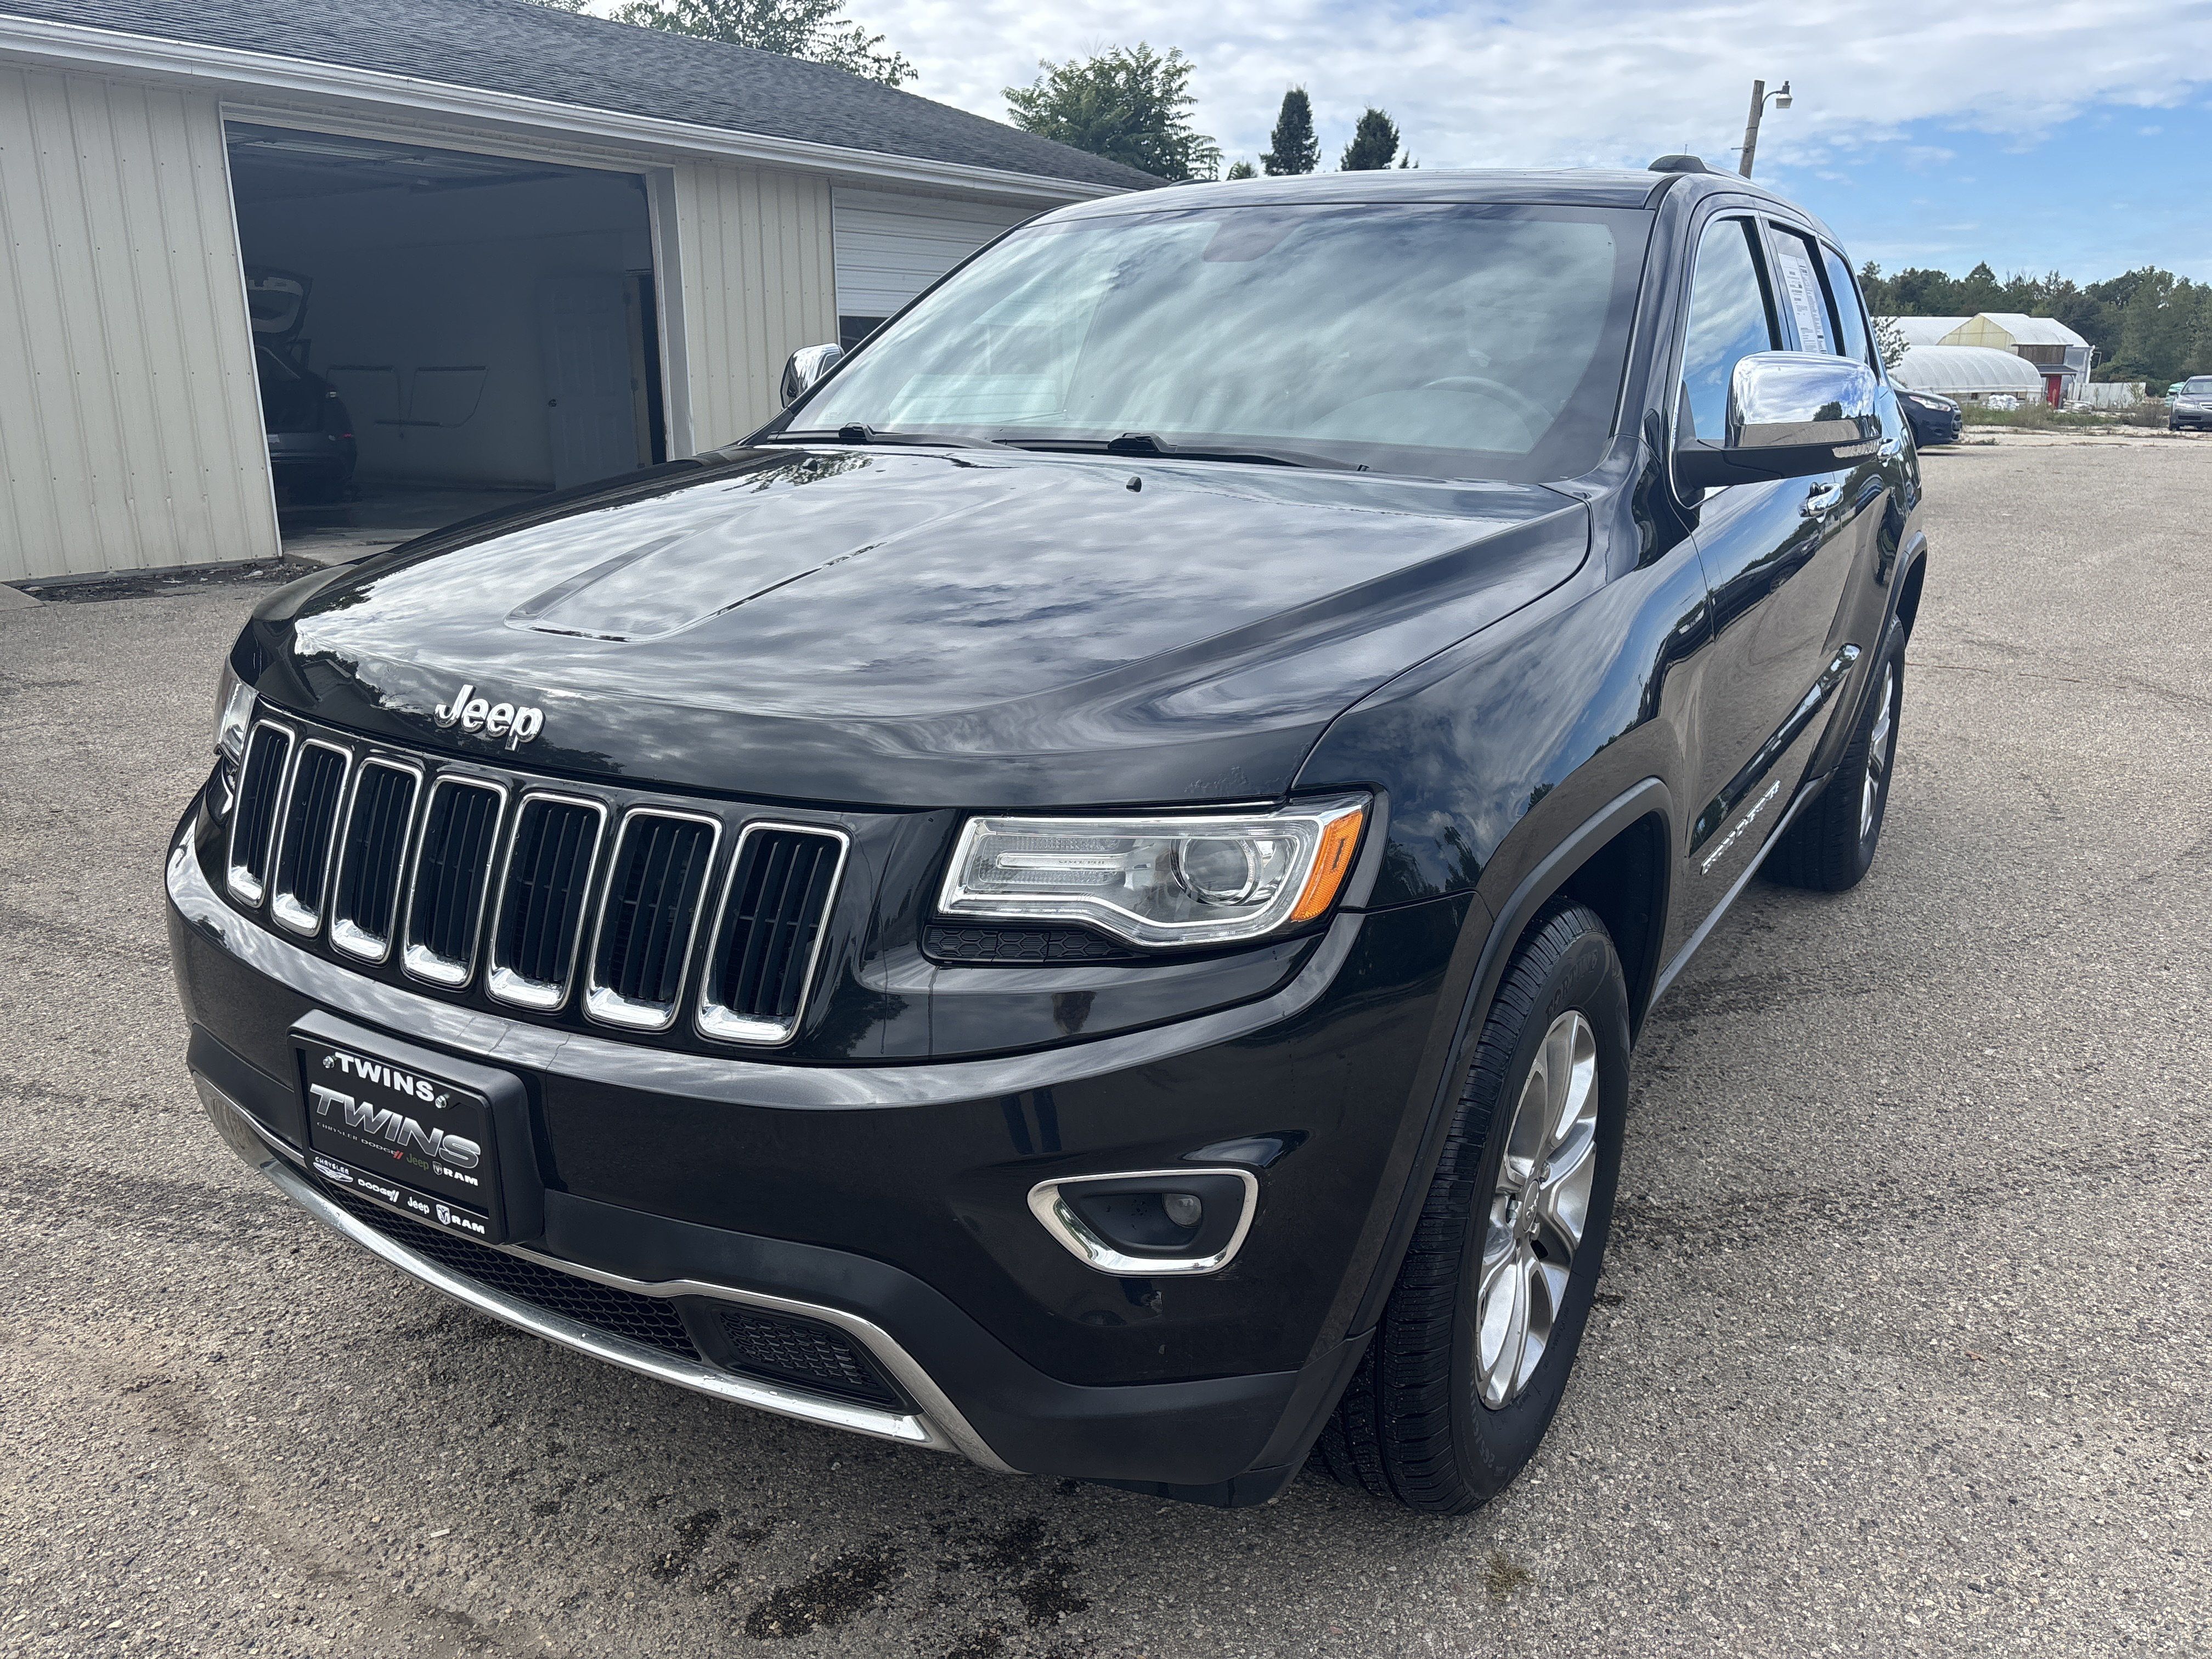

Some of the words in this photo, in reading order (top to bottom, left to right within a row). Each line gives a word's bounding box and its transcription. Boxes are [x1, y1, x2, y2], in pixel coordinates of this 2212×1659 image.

[434, 684, 545, 752] Jeep
[335, 1052, 435, 1102] TWINS
[310, 1083, 481, 1169] TWINS
[315, 1156, 349, 1175] CHRYSLER
[358, 1178, 396, 1199] DODGE
[407, 1197, 430, 1214] Jeep
[452, 1215, 486, 1234] RAM
[361, 1138, 399, 1156] DODGE
[407, 1153, 430, 1171] Jeep
[443, 1167, 479, 1186] RAM
